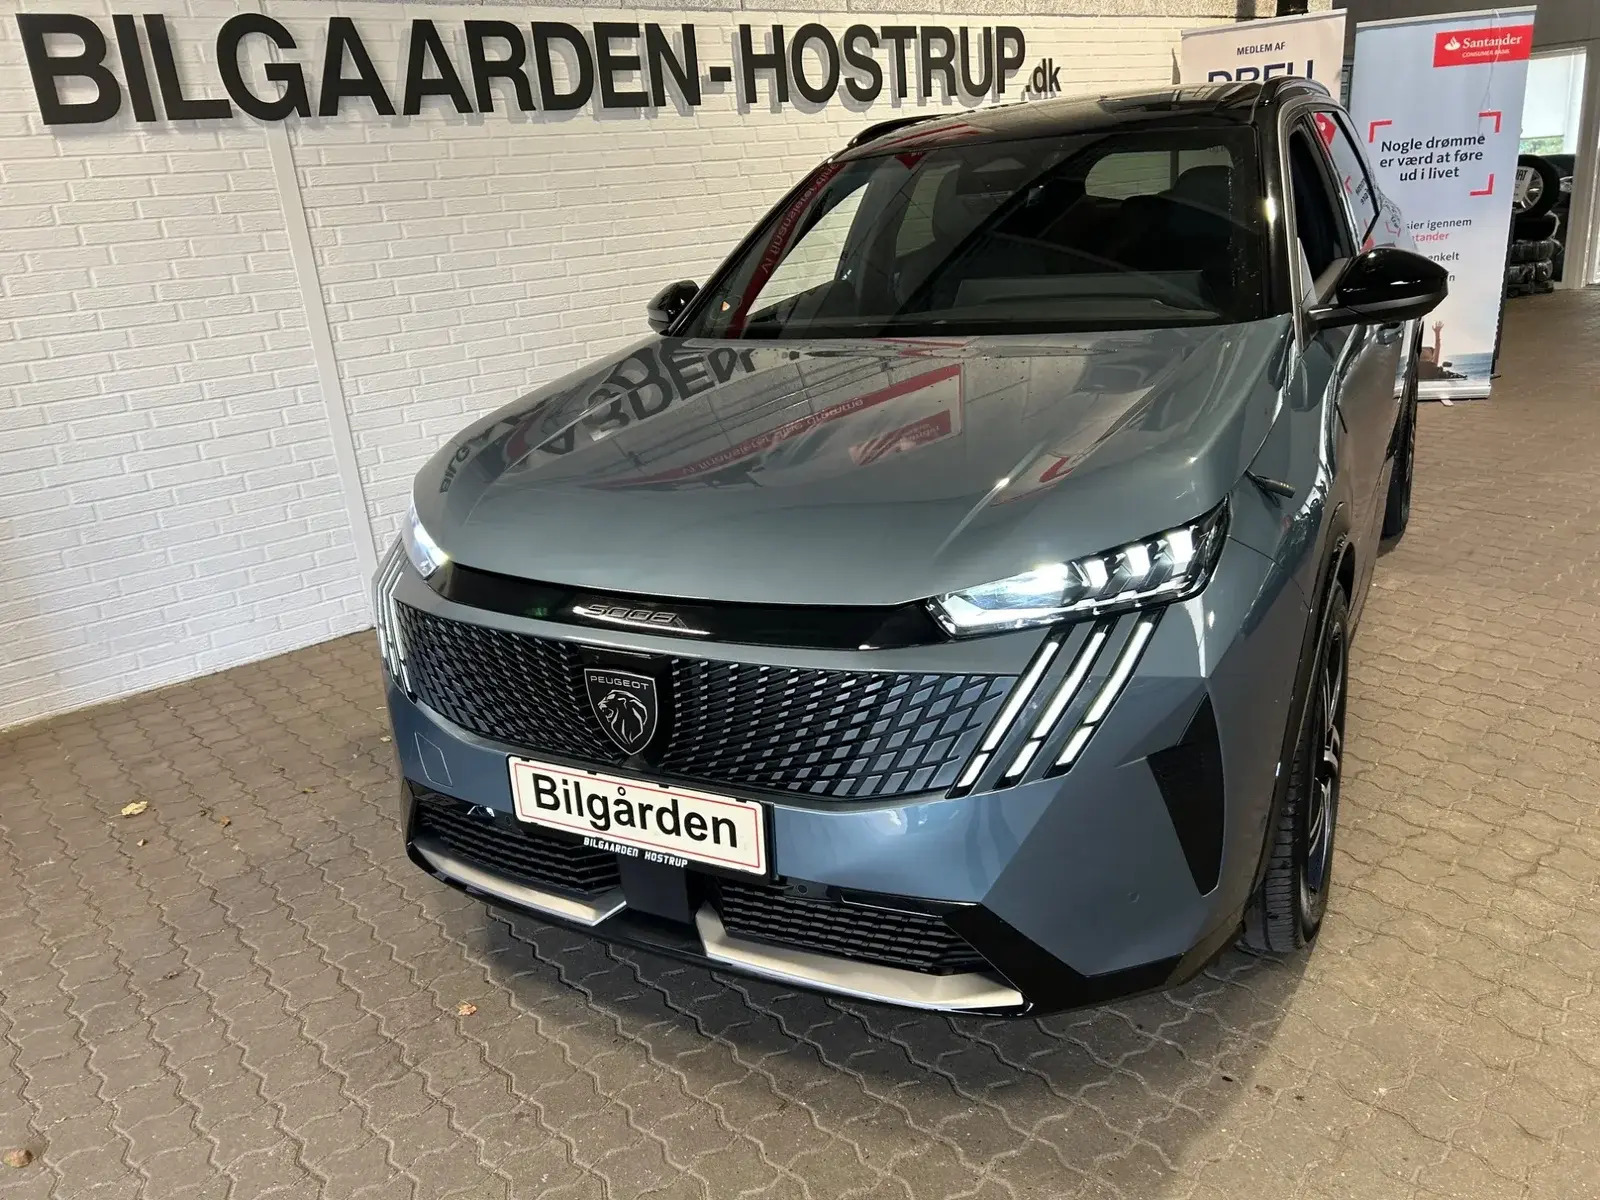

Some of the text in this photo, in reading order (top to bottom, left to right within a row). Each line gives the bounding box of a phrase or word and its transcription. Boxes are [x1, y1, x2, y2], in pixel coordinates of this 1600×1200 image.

[1236, 41, 1286, 56] MEDLEM AF
[1462, 33, 1522, 49] Santander
[1462, 50, 1494, 58] CONSUMER
[1381, 135, 1486, 154] Nogle drømme
[1380, 149, 1484, 168] er værd at føre
[1399, 166, 1460, 181] ud i livet
[1427, 219, 1472, 231] igennem
[583, 604, 688, 629] 5008
[590, 675, 650, 690] PEUGEOT
[532, 773, 738, 848] Bilgården
[583, 837, 689, 868] BILGAARDEN HOSTRUP
